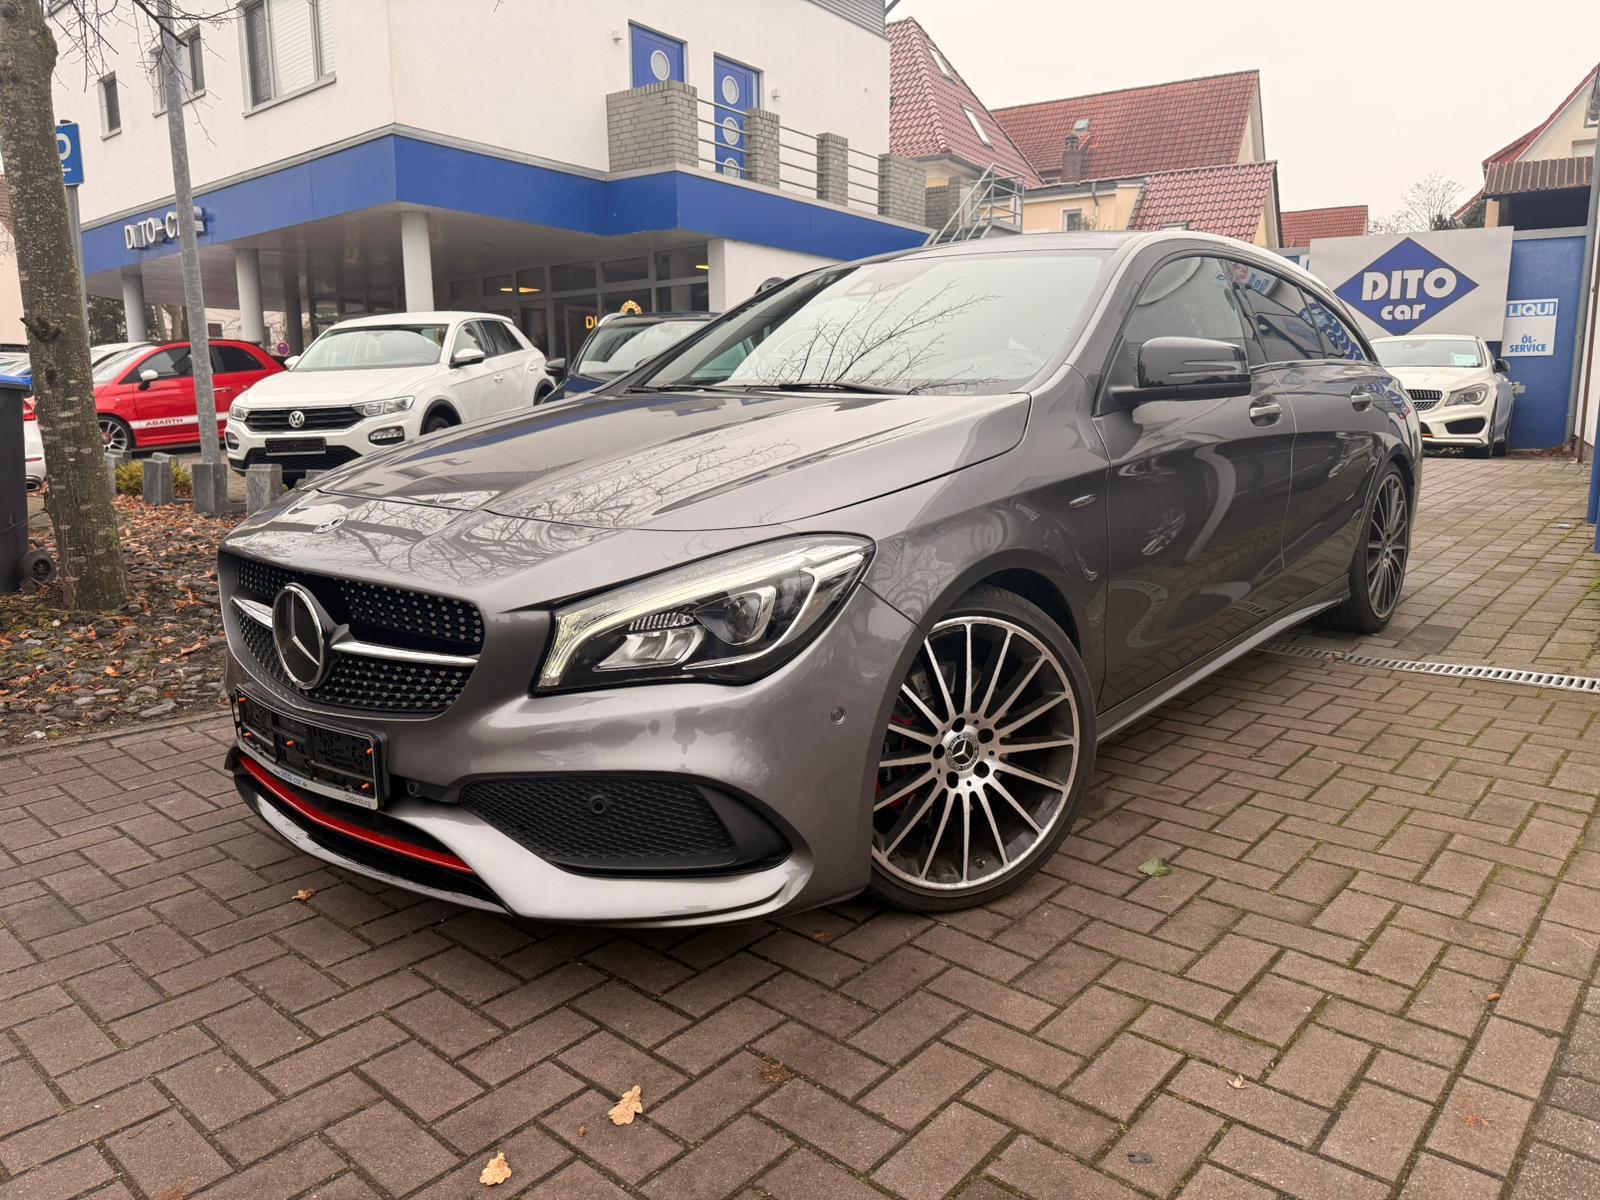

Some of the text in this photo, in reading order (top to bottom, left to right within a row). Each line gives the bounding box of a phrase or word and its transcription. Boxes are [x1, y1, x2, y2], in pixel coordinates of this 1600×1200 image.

[124, 206, 204, 249] DITO-C
[1361, 267, 1457, 301] DITO
[1380, 303, 1426, 321] car
[1508, 302, 1555, 317] LIQUI
[1509, 343, 1546, 353] SERVICE
[145, 418, 183, 427] ABARTH
